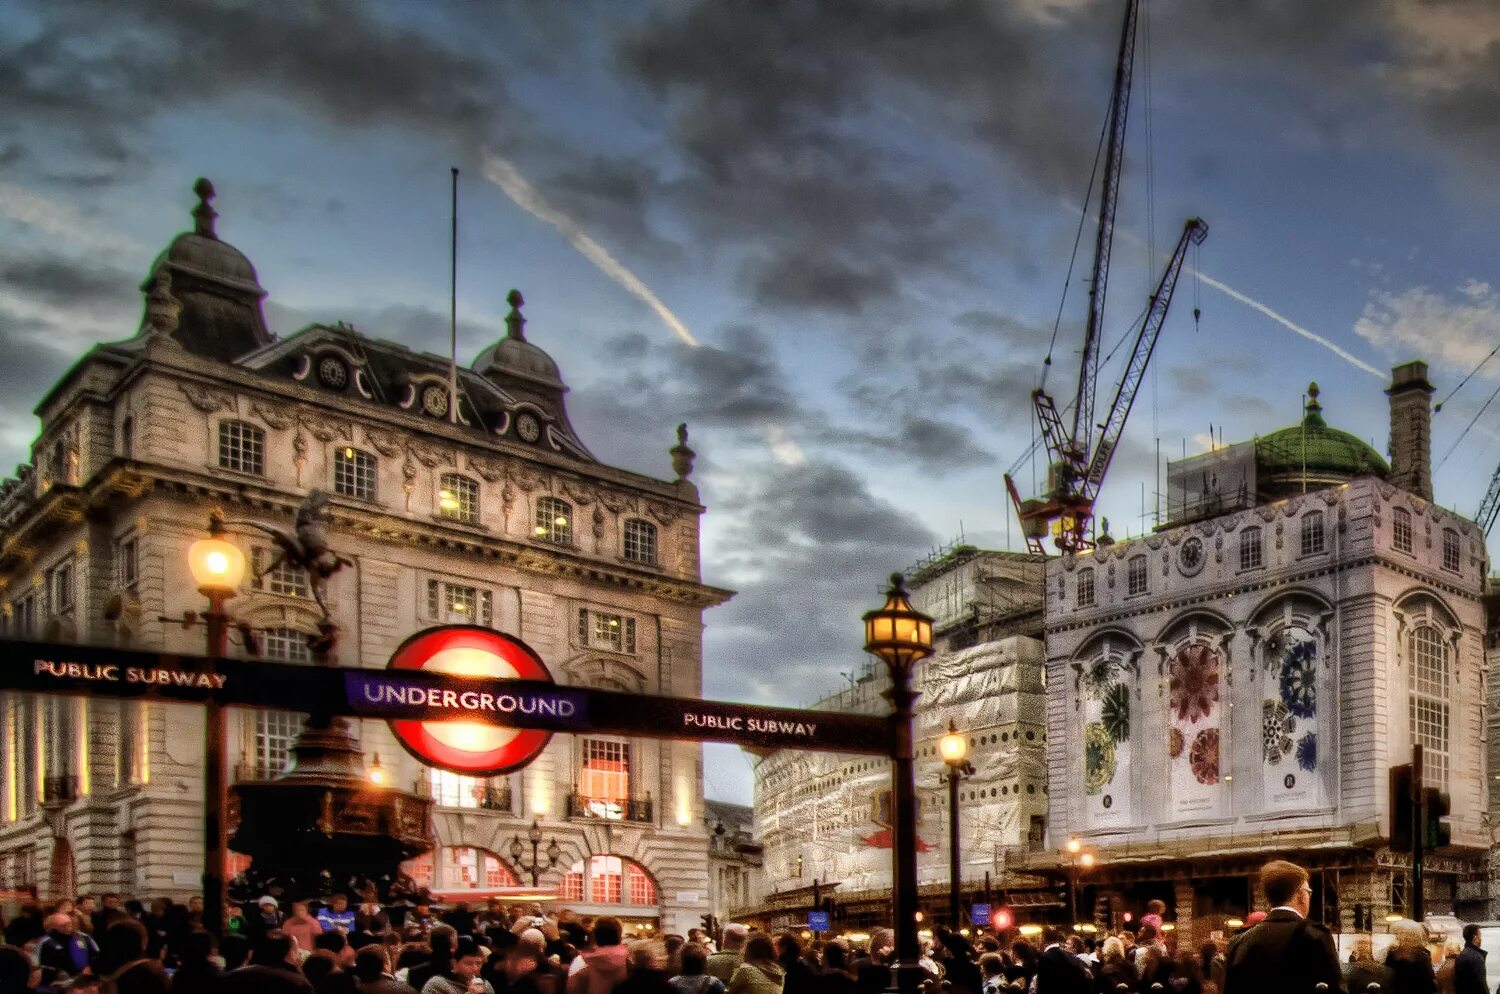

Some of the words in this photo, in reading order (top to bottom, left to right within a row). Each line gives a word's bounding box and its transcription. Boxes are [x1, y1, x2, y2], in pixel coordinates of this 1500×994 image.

[33, 659, 119, 681] PUBLIC
[126, 667, 227, 689] SUBWAY
[364, 683, 575, 717] UNDERGROUND
[684, 712, 742, 730] PUBLIC
[747, 718, 817, 736] SUBWAY
